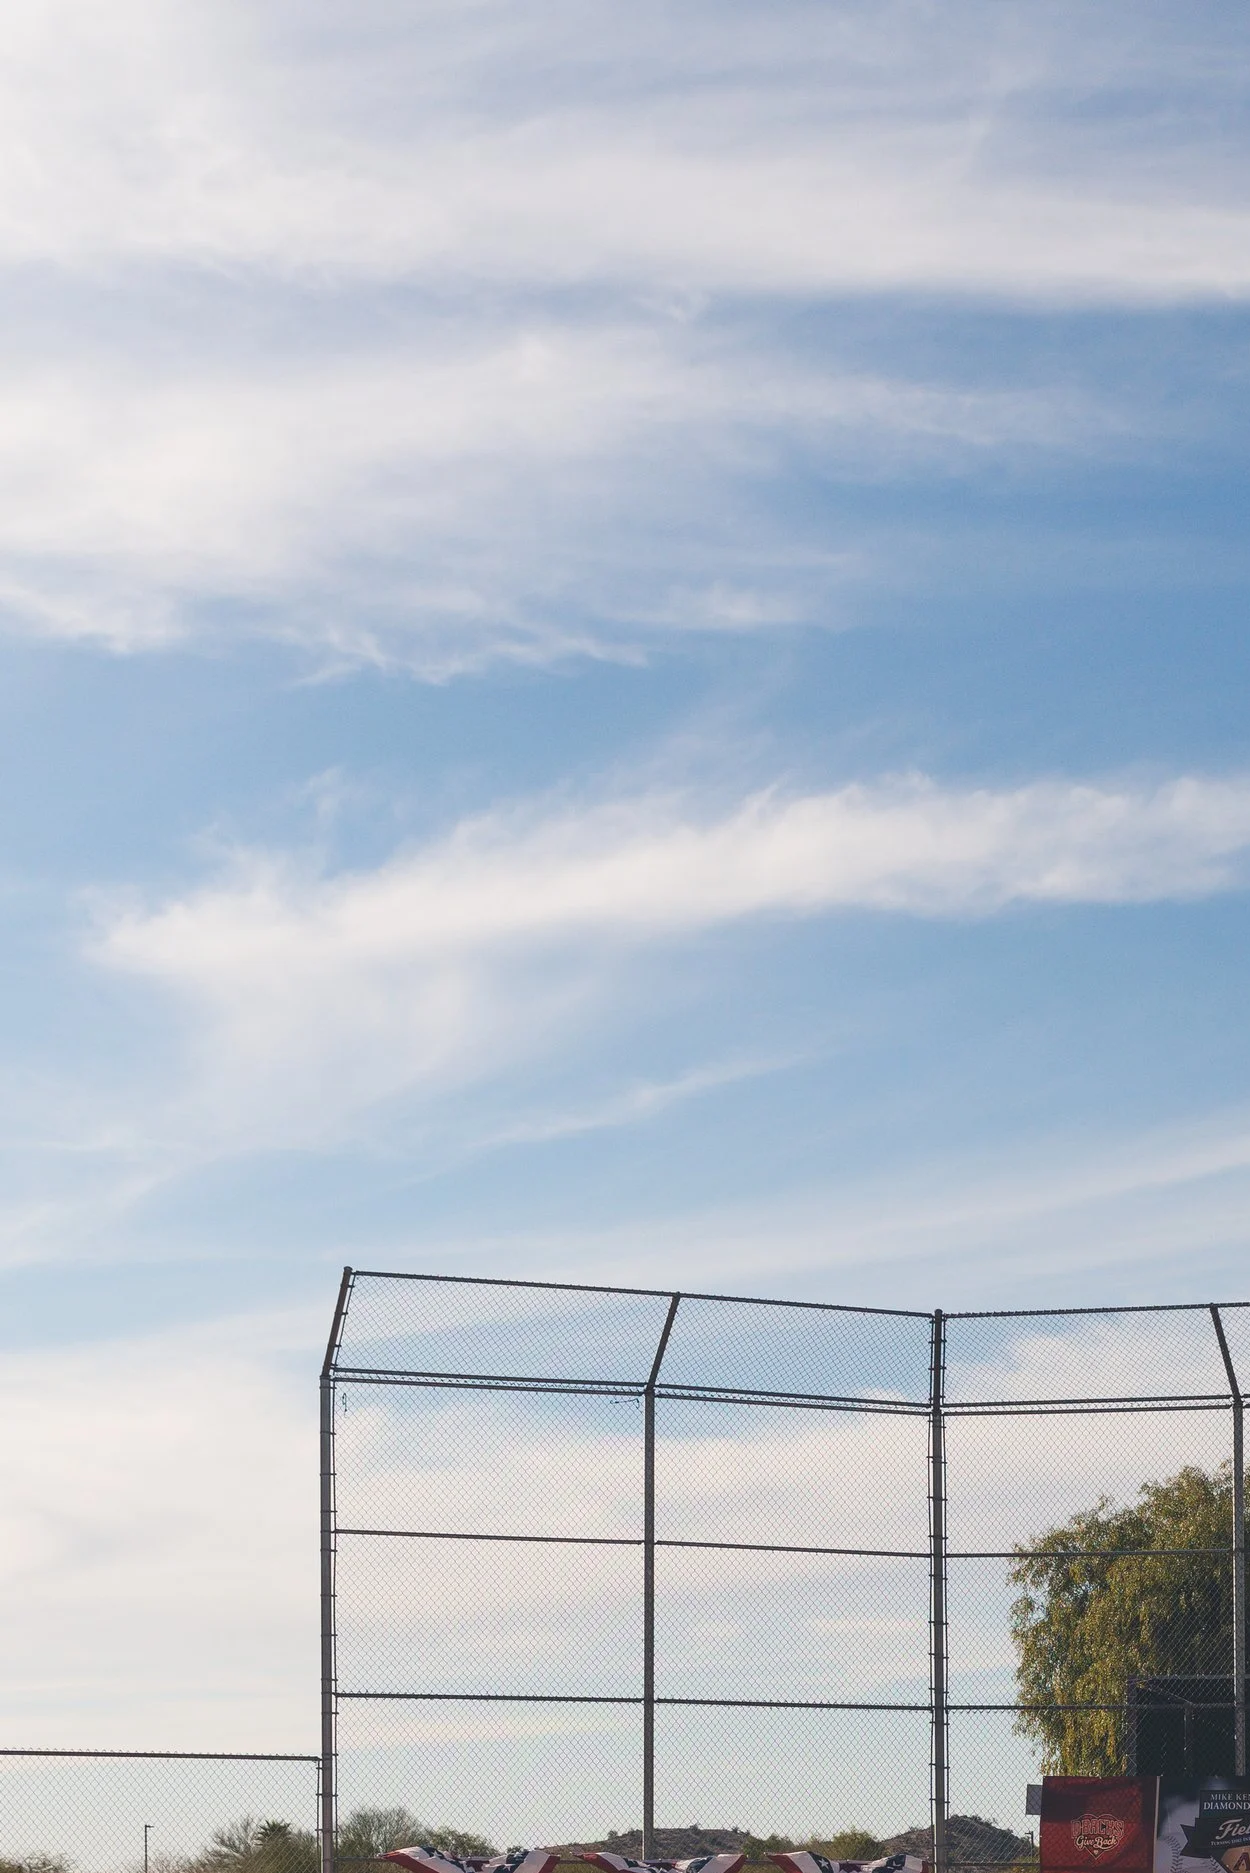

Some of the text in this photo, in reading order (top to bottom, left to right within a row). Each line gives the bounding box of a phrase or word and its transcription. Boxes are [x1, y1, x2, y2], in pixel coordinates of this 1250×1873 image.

[1210, 1793, 1233, 1801] MIKE
[1076, 1835, 1118, 1849] Give Back
